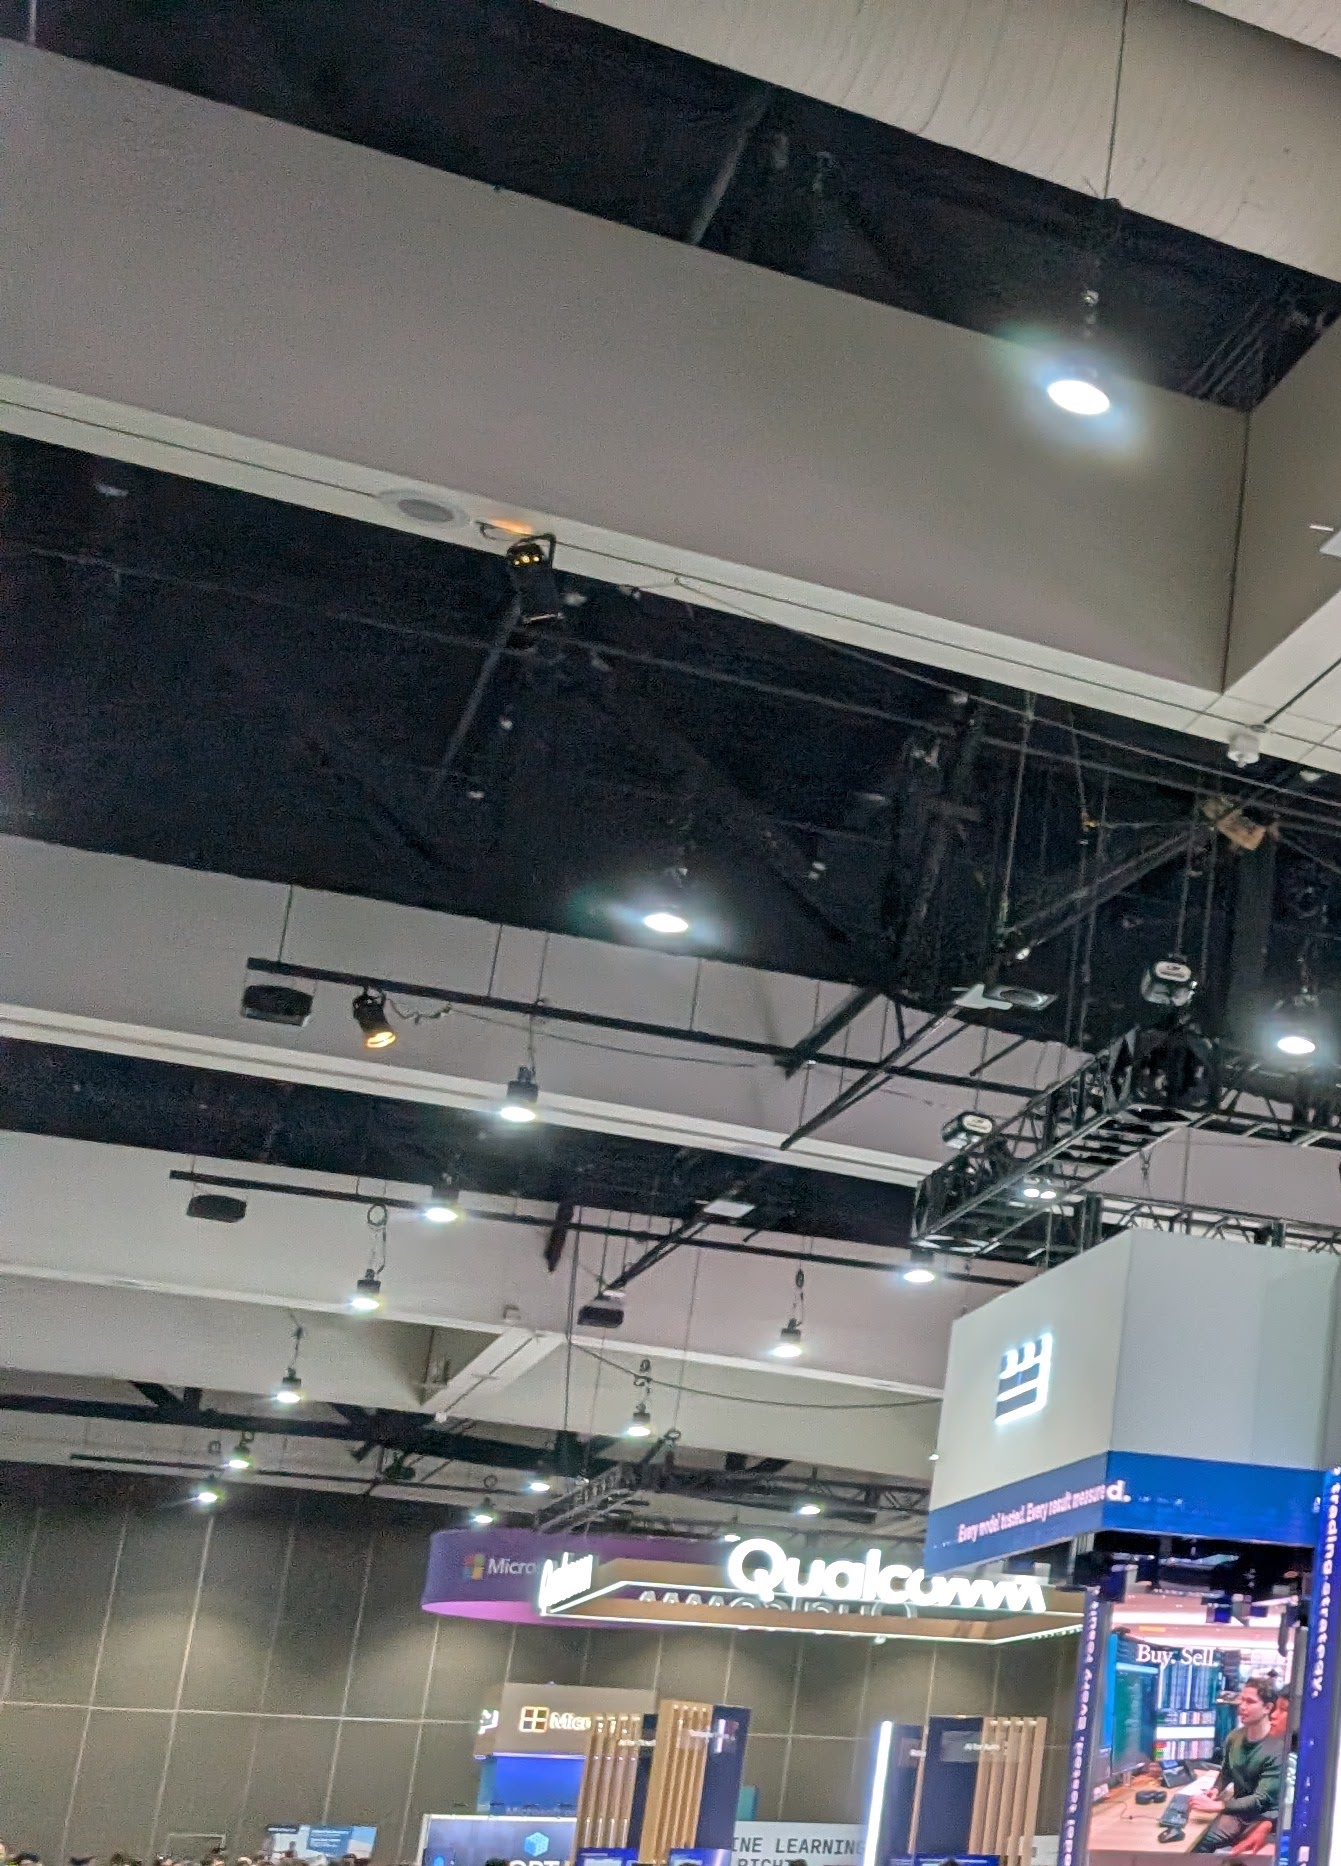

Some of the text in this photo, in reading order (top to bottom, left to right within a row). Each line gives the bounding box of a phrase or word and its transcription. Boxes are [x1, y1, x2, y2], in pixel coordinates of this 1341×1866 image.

[957, 1523, 979, 1544] Every
[1026, 1502, 1049, 1523] Every
[1135, 1643, 1219, 1671] Buy. Sell.
